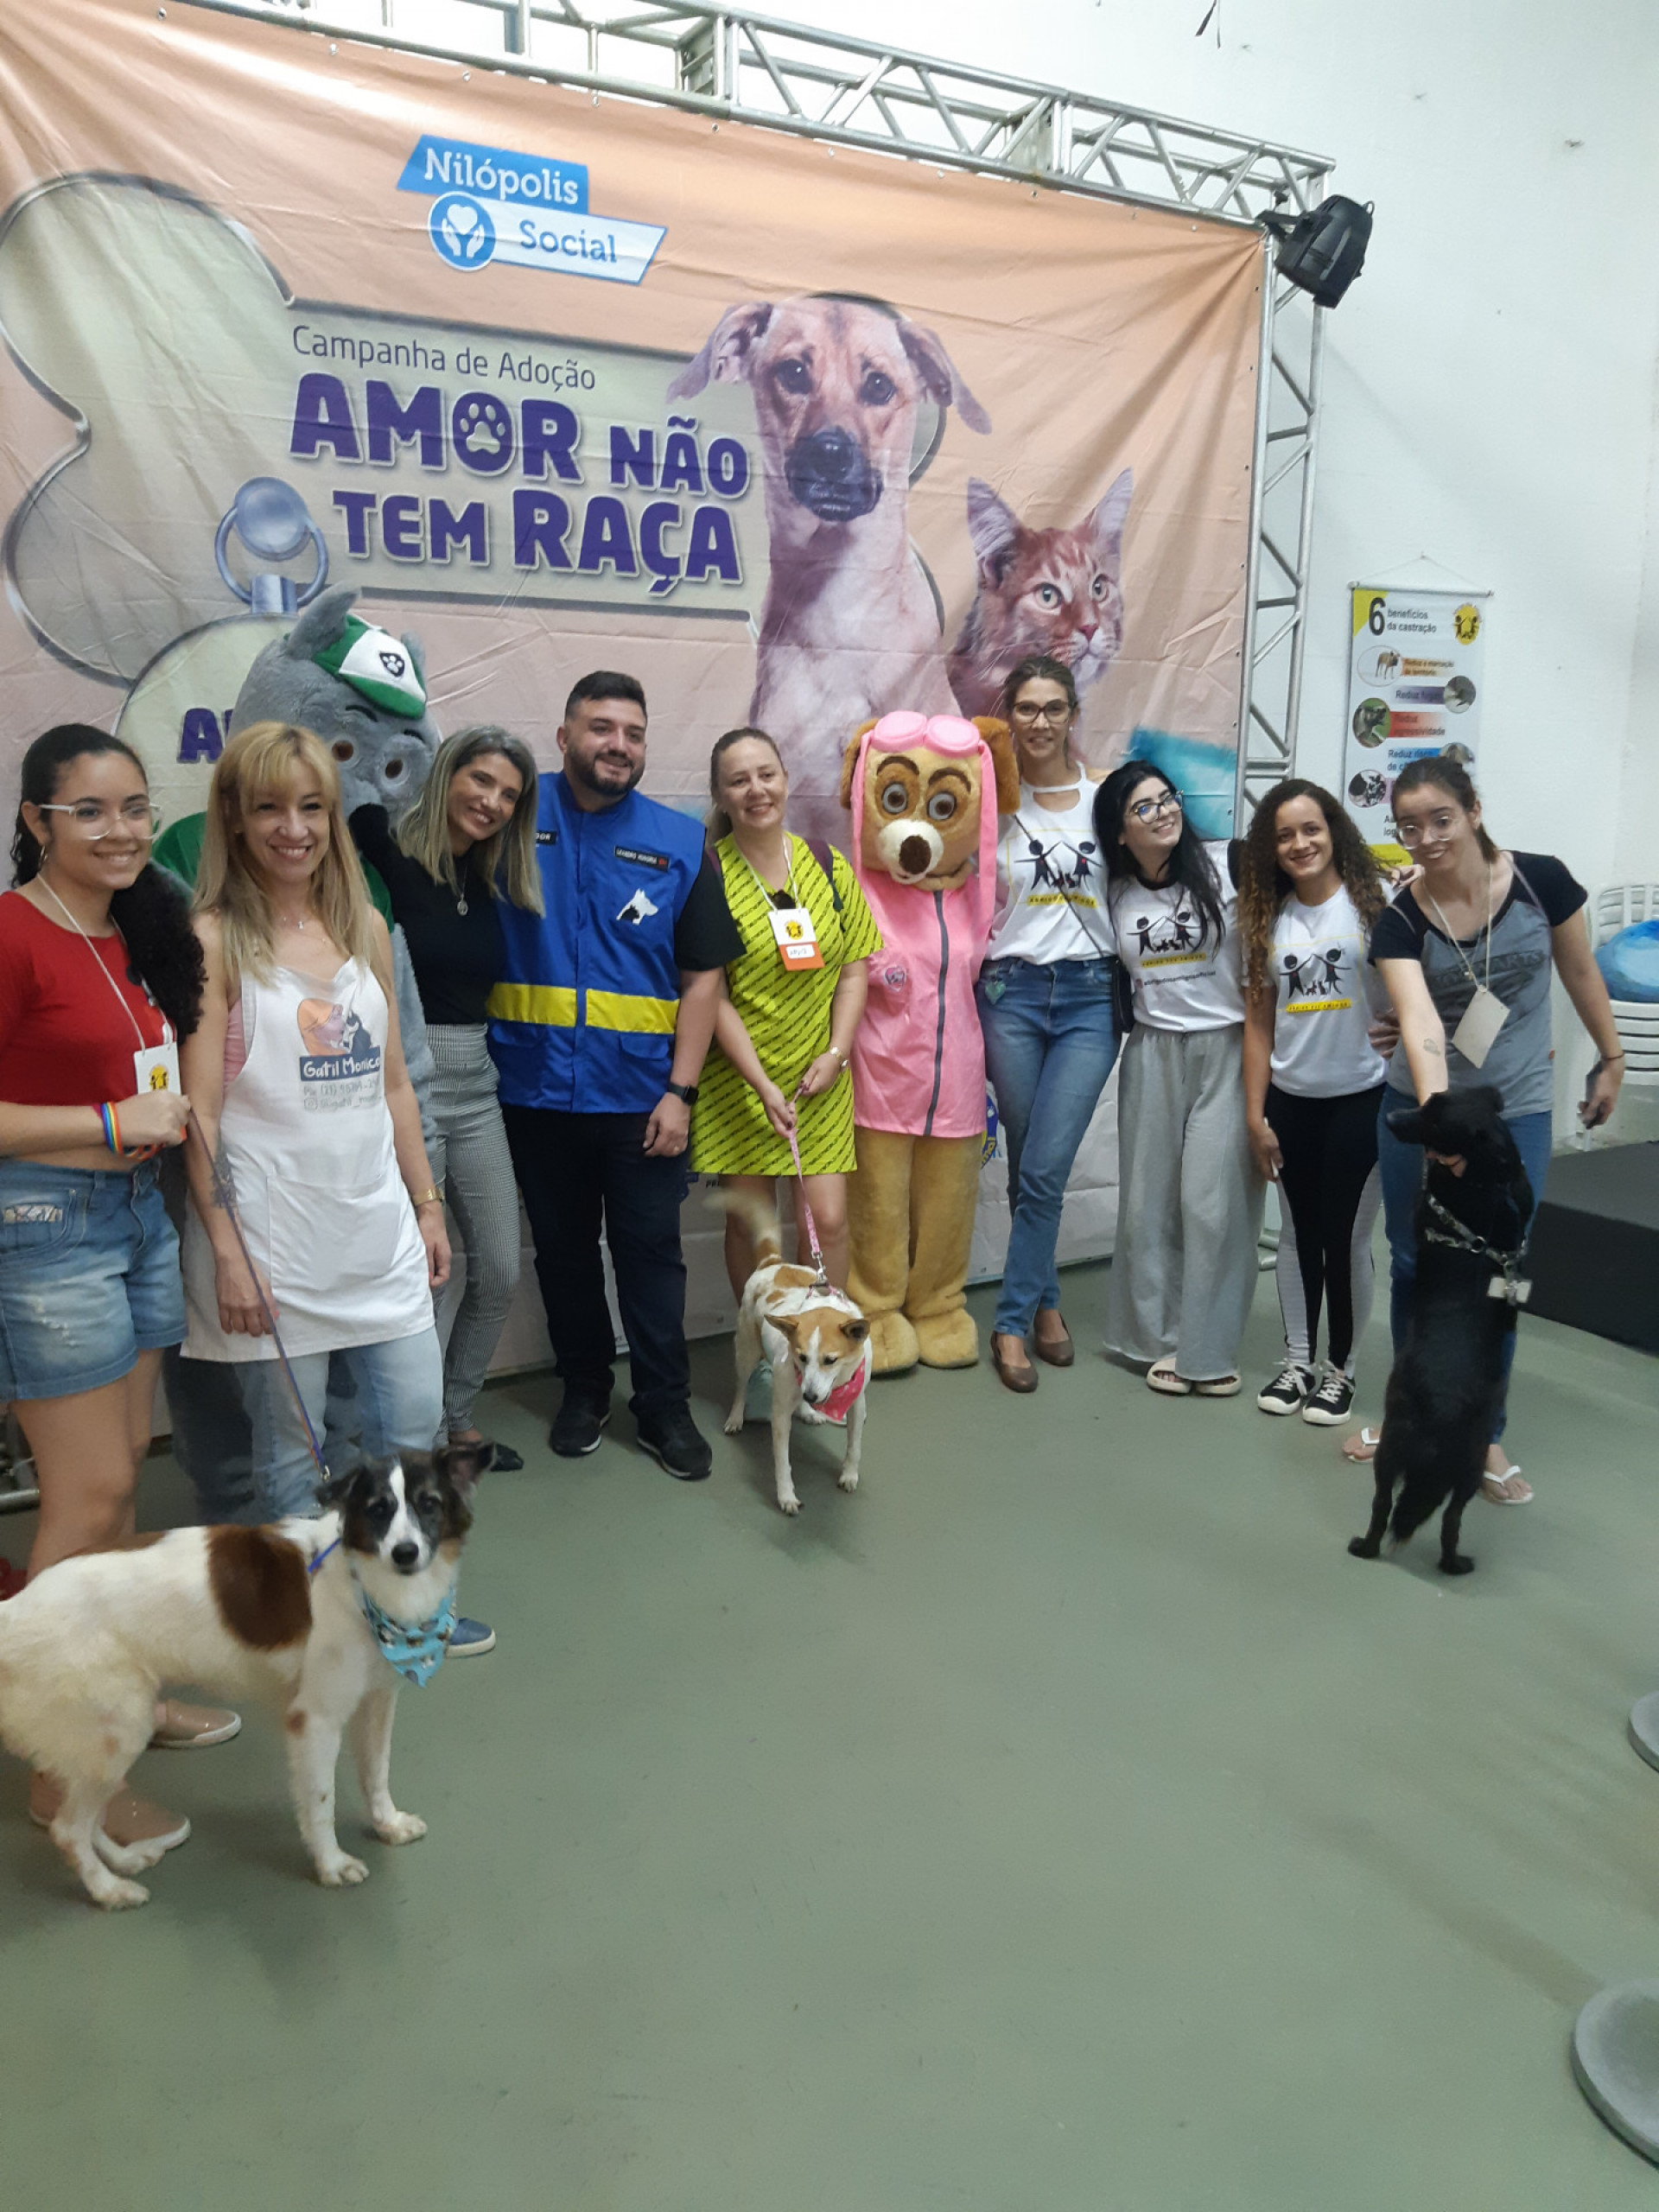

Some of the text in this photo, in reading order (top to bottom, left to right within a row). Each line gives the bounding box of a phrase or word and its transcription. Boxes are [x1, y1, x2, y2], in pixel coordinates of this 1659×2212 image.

[423, 148, 579, 205] Nilópolis
[518, 219, 617, 263] Social
[293, 325, 596, 393] Campanha de Adoção
[289, 372, 748, 496] AMOR NÃO
[333, 489, 742, 594] TEM RAÇA
[1368, 596, 1386, 636] 6
[1387, 621, 1396, 631] da
[1388, 749, 1413, 759] Reduz
[303, 1060, 340, 1078] Gatil
